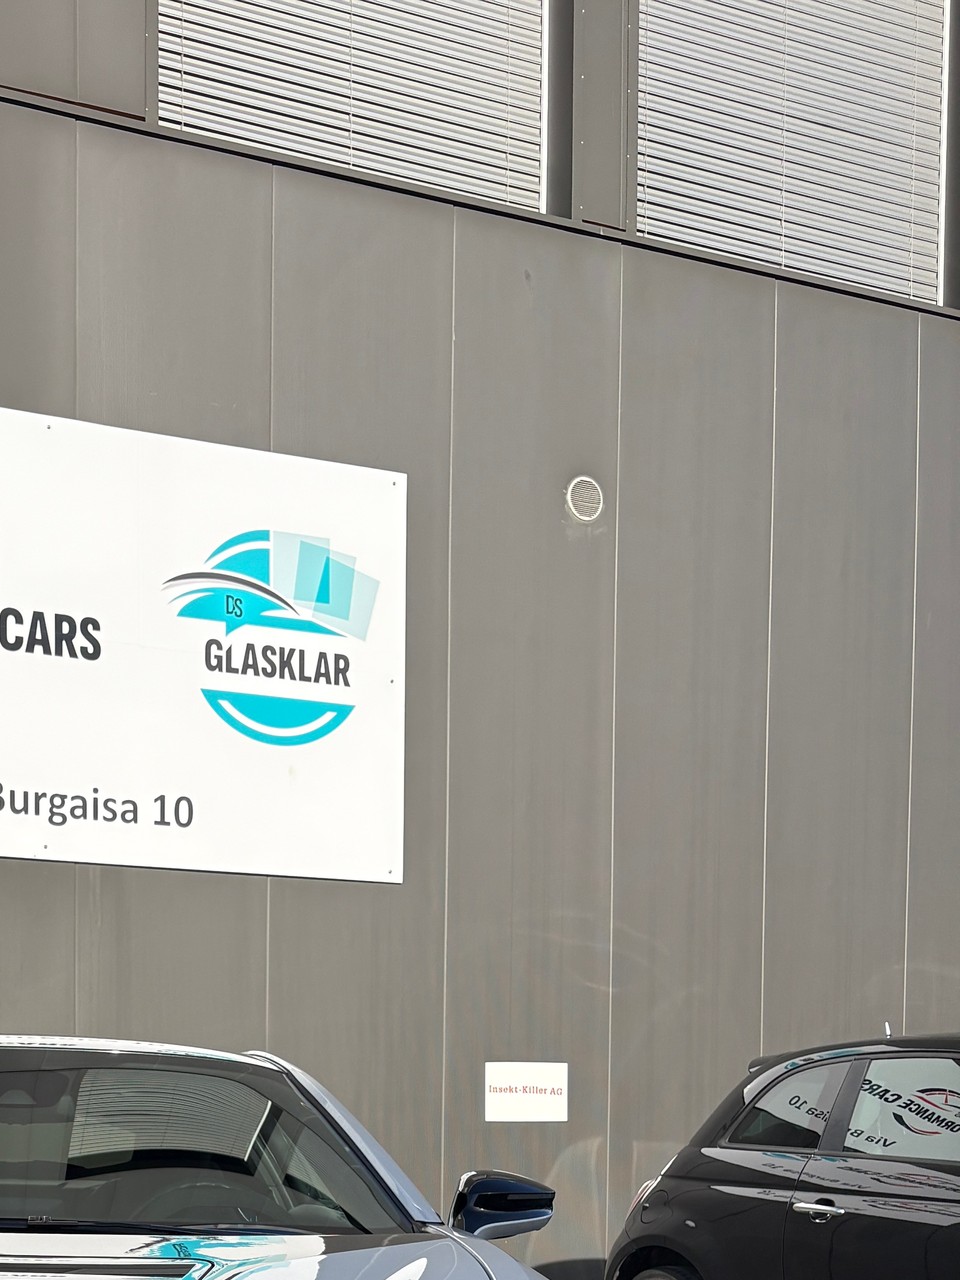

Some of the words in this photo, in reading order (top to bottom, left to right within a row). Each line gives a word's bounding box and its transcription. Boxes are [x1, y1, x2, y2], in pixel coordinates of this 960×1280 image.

[226, 594, 243, 618] DS
[204, 638, 351, 688] GLASKLAR
[154, 794, 194, 828] 10
[488, 1084, 548, 1095] Insekt-Killer
[549, 1087, 563, 1096] AG
